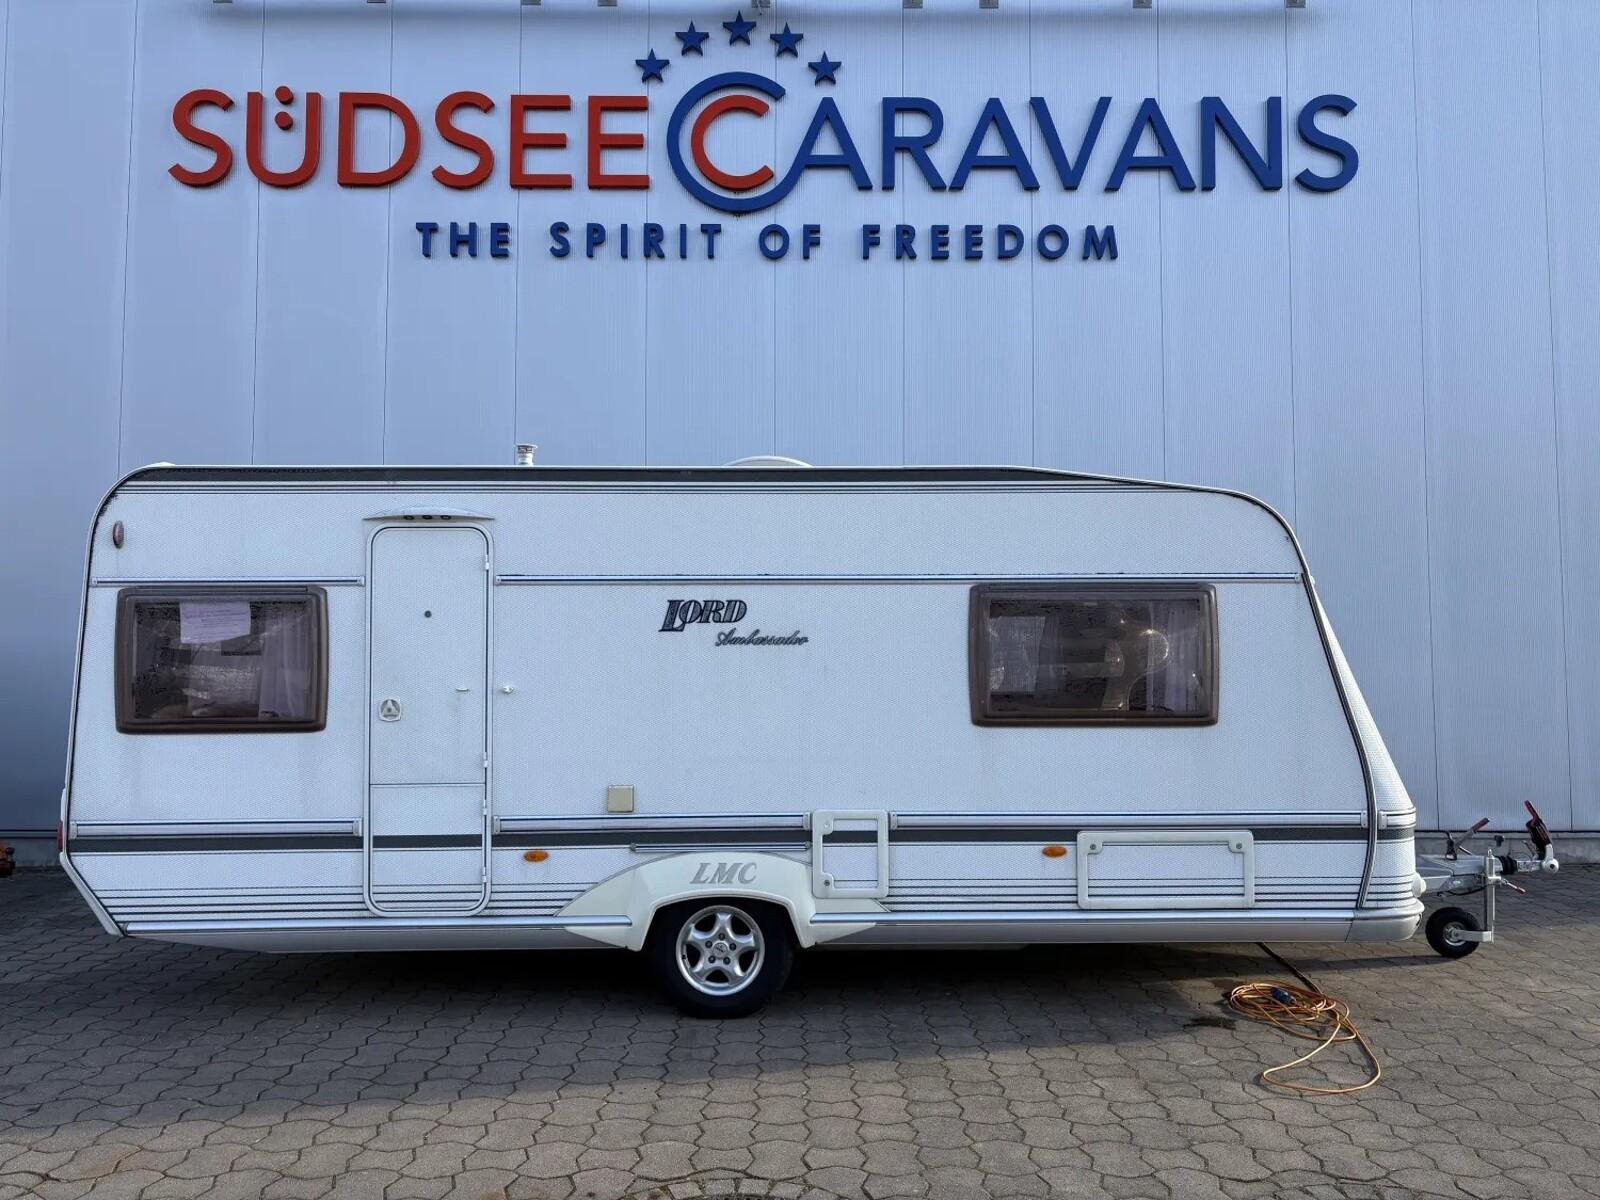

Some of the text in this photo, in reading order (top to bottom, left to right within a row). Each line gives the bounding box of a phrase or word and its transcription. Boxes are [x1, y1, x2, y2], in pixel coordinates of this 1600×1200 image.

[168, 71, 1360, 214] SÜDSEE CARAVANS
[415, 222, 1119, 260] THE SPIRIT OF FREEDOM
[658, 599, 747, 632] LORD
[715, 627, 809, 647] Ambassador
[689, 862, 758, 885] LMC
